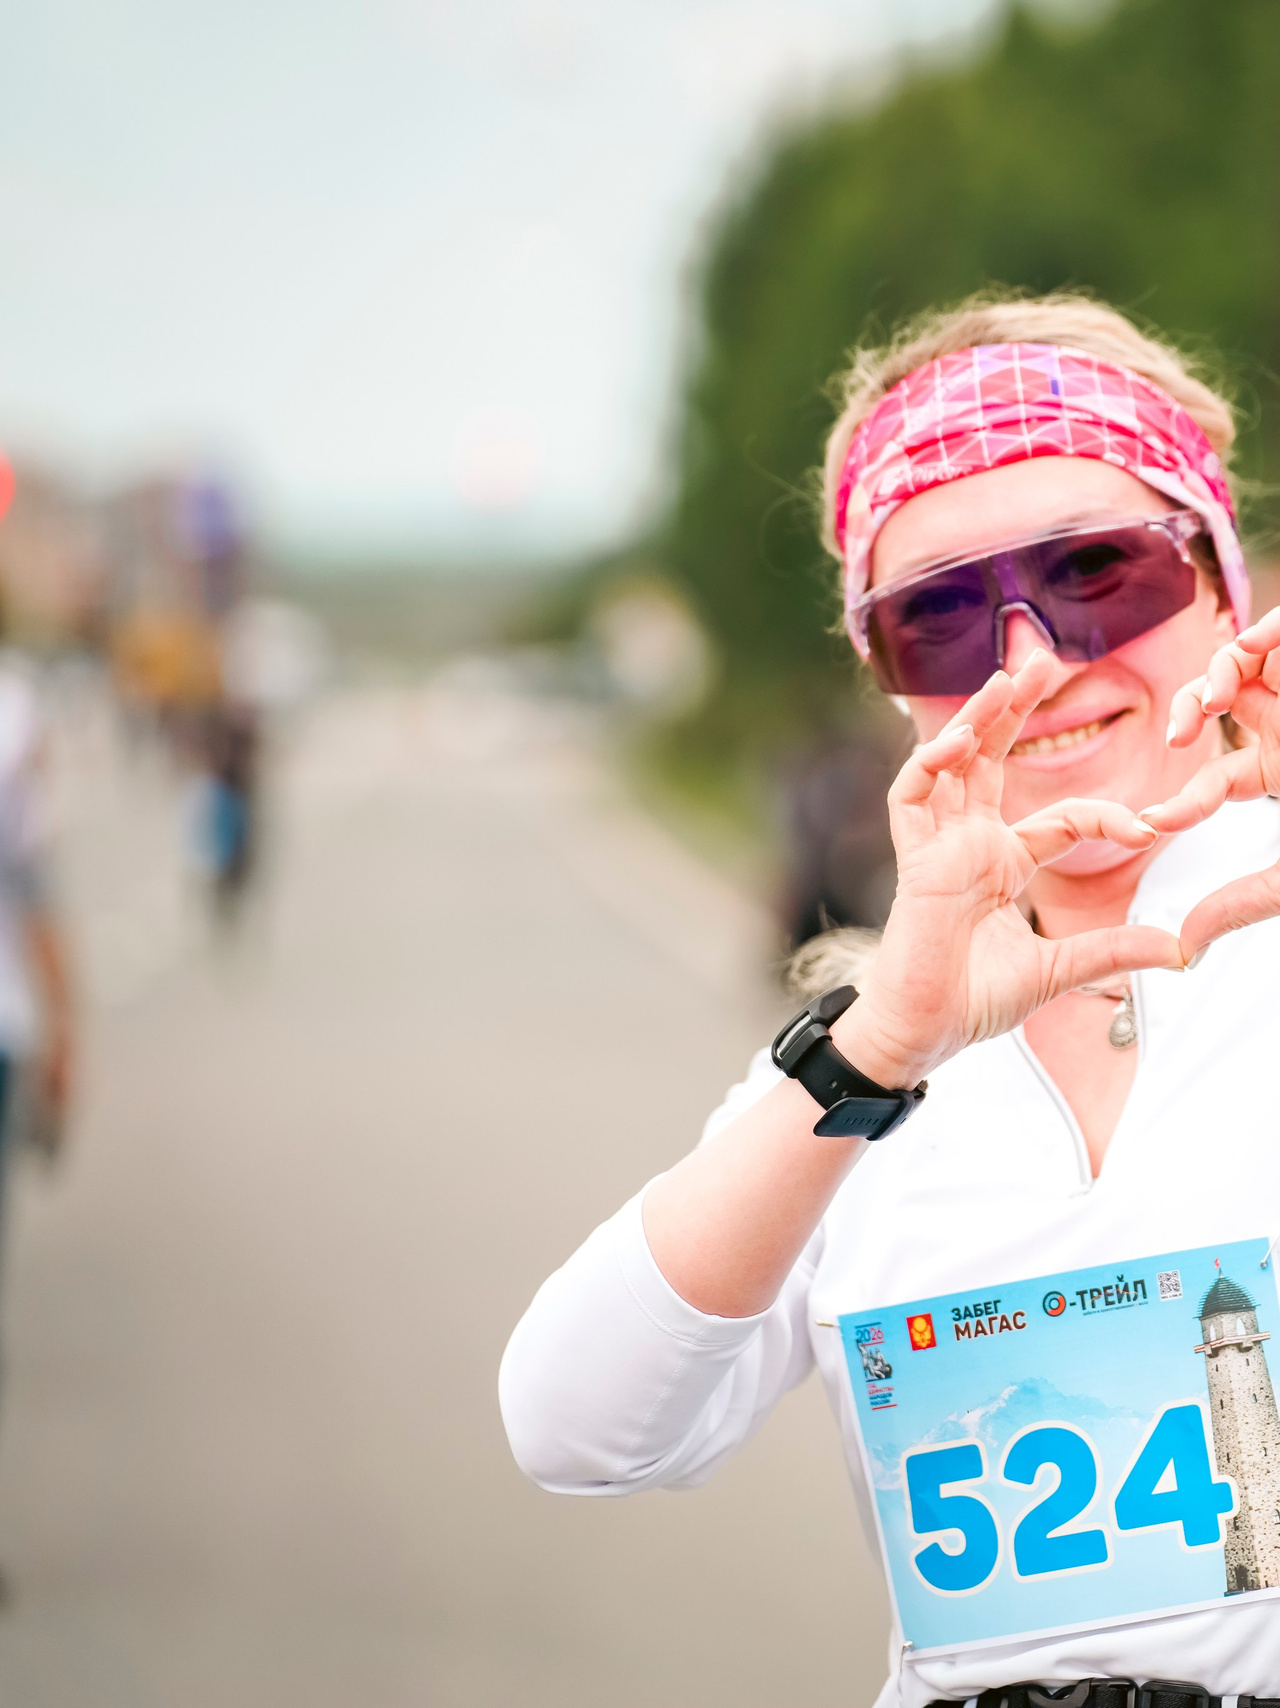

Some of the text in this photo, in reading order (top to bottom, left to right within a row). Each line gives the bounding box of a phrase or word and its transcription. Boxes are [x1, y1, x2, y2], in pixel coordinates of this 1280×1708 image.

[951, 1300, 1001, 1322] ЗАБЕГ
[856, 1326, 884, 1342] 2026
[953, 1310, 1028, 1341] МАГАС
[903, 1400, 1238, 1595] 524
